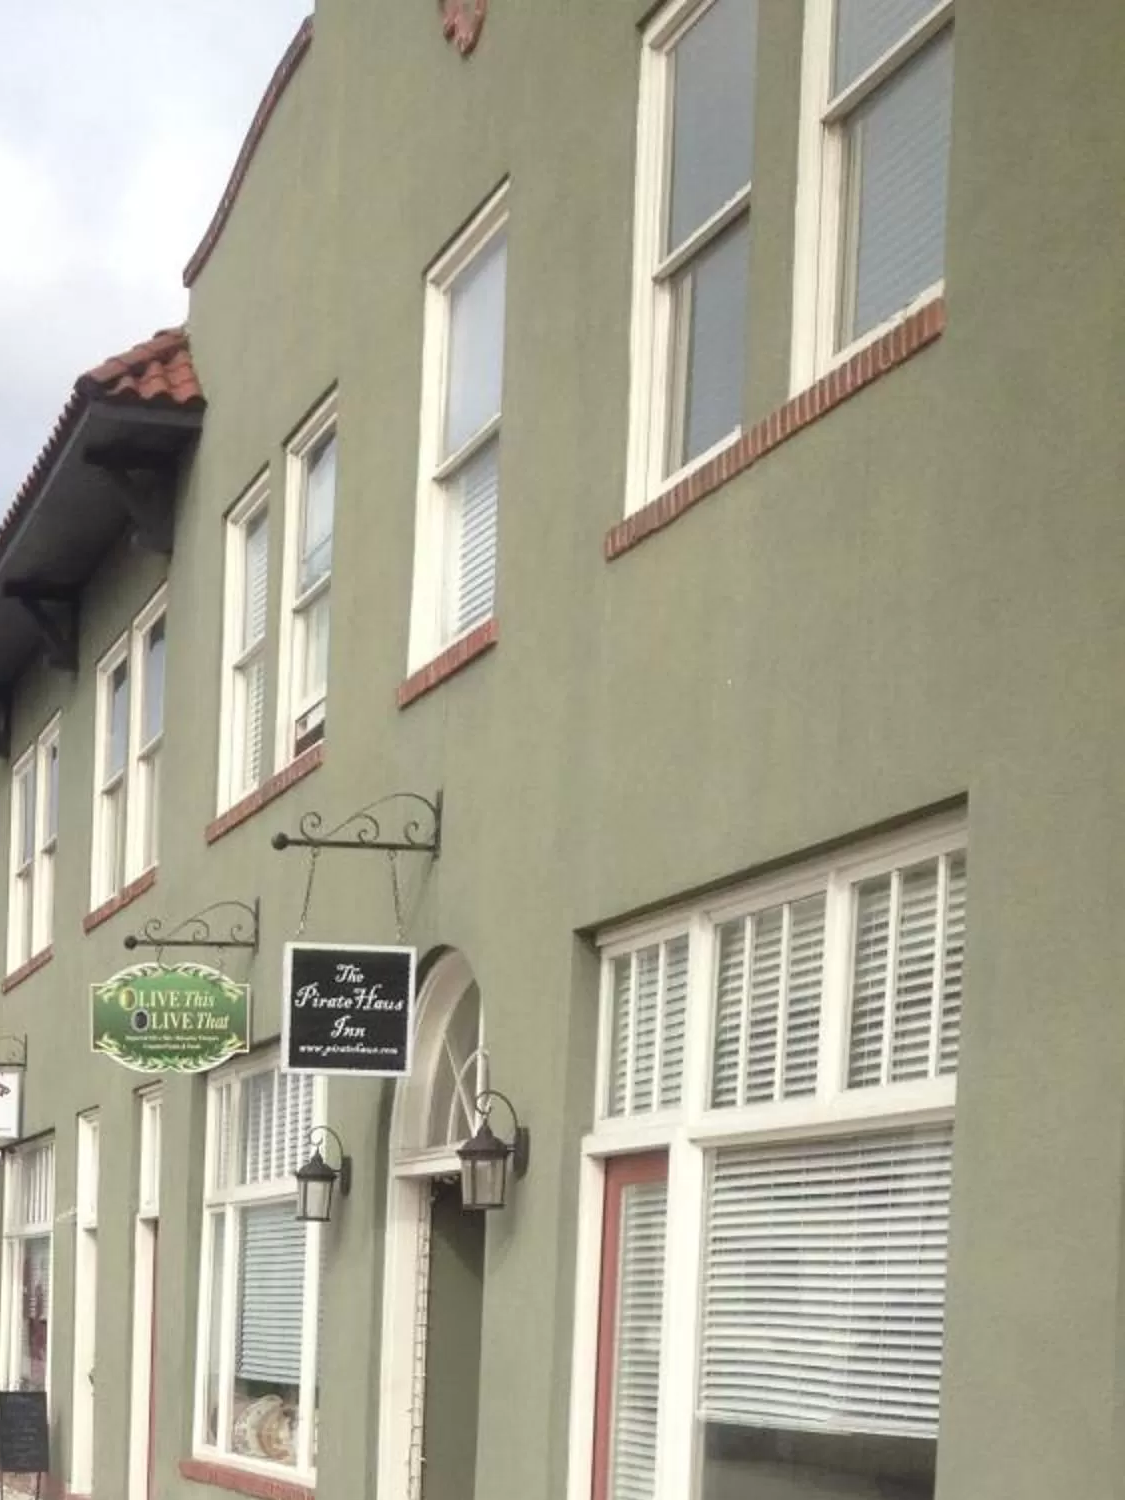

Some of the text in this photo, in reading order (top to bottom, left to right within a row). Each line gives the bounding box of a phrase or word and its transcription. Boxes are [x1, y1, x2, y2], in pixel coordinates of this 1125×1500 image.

[335, 963, 364, 983] The
[119, 987, 215, 1011] OLIVE This
[294, 981, 404, 1011] Pirate Haus
[131, 1008, 230, 1032] OLIVE That
[330, 1015, 366, 1039] Inn
